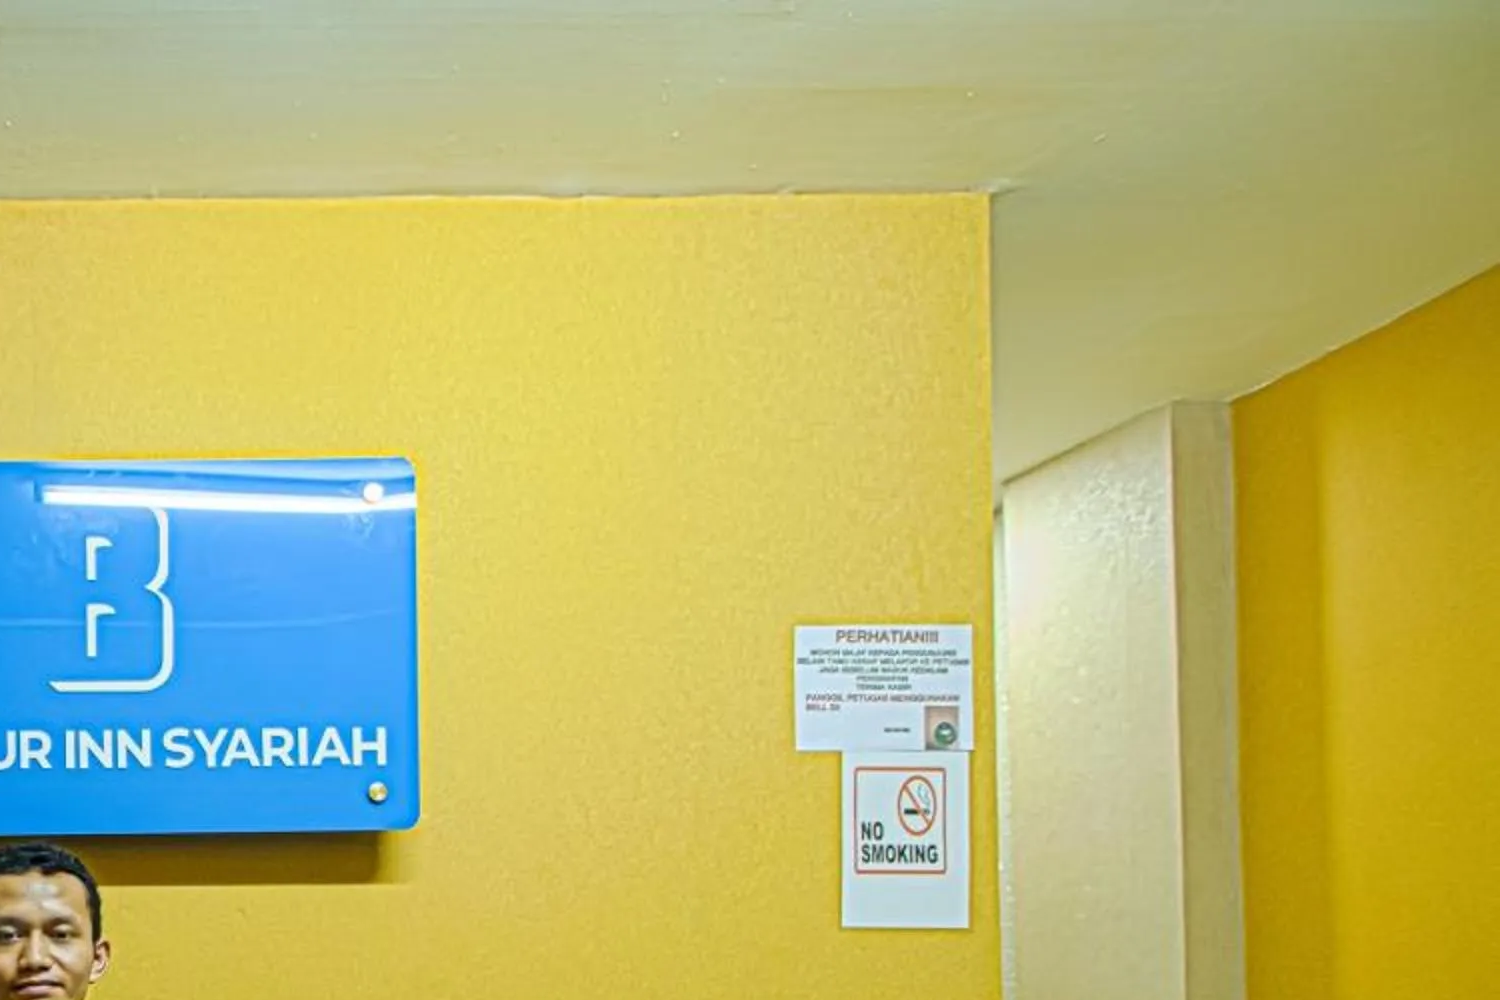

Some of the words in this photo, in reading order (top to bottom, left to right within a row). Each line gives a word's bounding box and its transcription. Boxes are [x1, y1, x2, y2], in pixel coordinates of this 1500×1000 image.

[65, 729, 153, 769] INN
[164, 726, 387, 769] SYARIAH
[861, 822, 884, 841] NO
[861, 844, 938, 864] SMOKING
